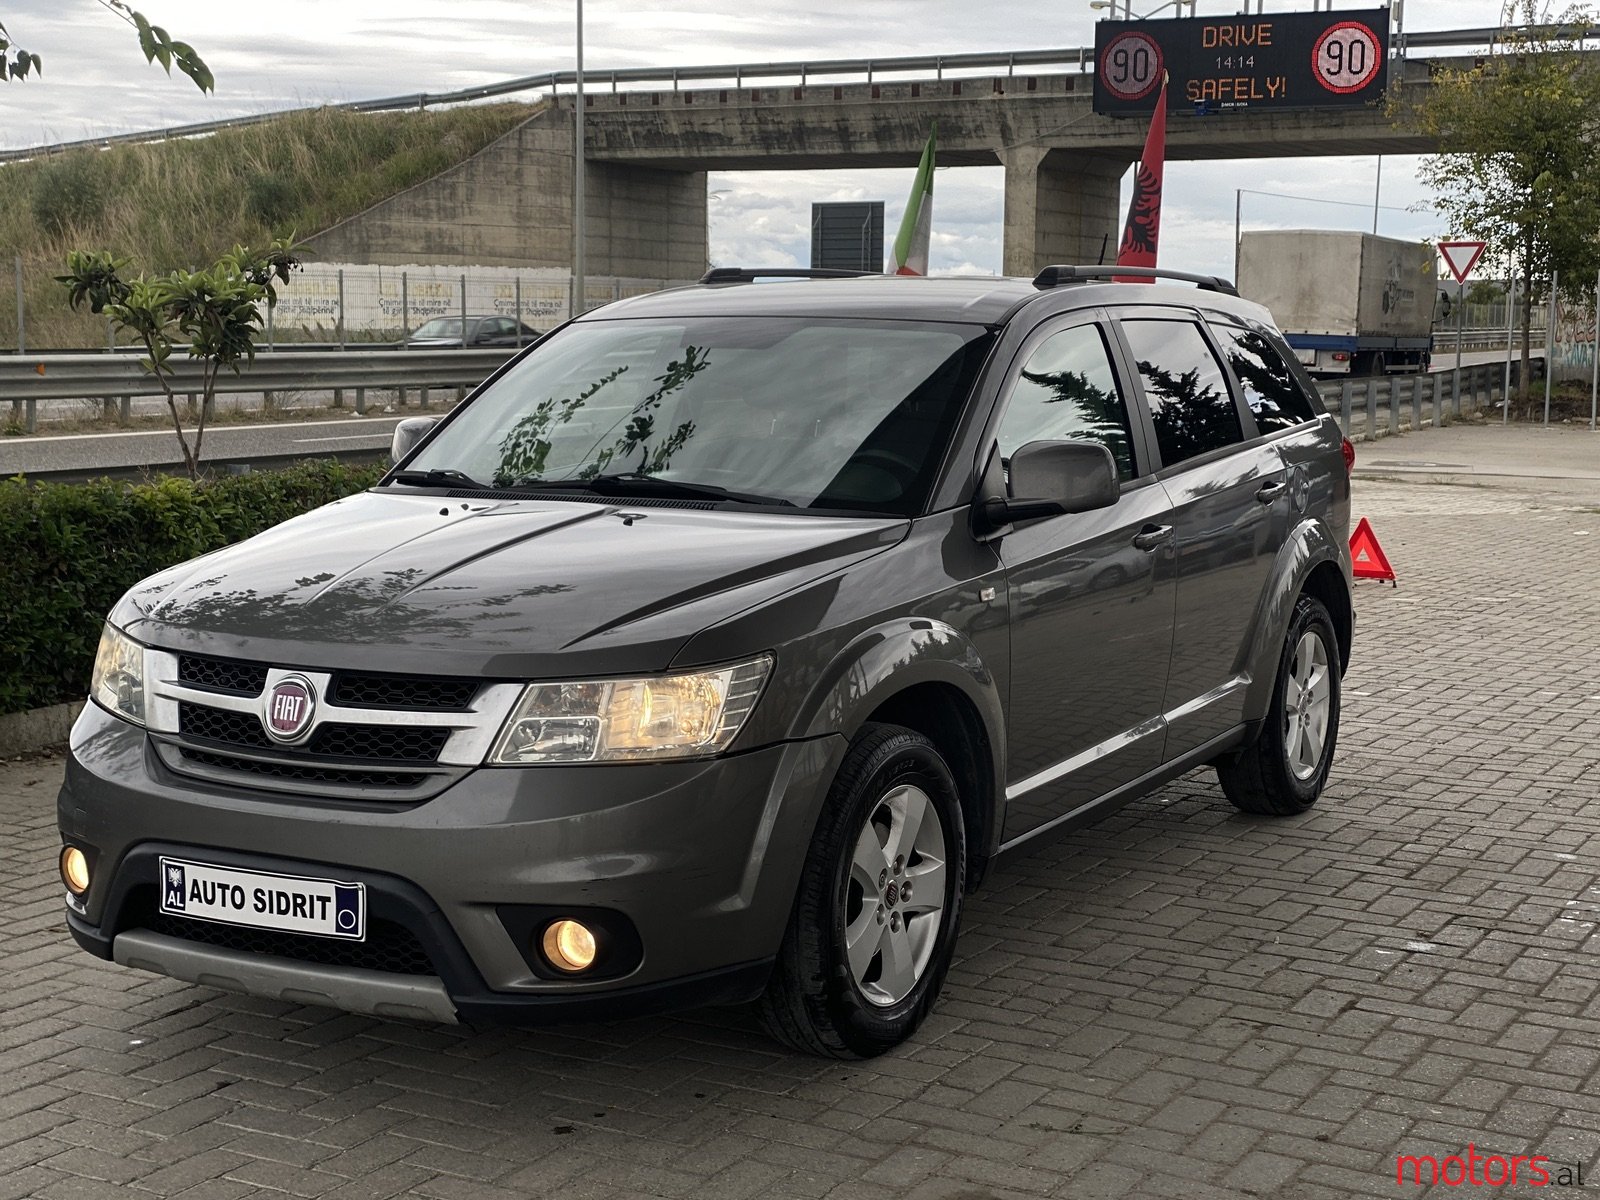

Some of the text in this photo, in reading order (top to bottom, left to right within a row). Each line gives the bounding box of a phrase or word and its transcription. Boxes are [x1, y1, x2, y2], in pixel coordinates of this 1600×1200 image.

[1202, 23, 1273, 48] DRIVE
[1112, 47, 1150, 84] 90
[1215, 55, 1255, 70] 14:14
[1325, 39, 1366, 76] 90
[1186, 76, 1287, 101] SAFELY!
[273, 694, 304, 722] FIAT
[166, 890, 185, 908] AL
[188, 878, 332, 921] AUTO SIDRIT
